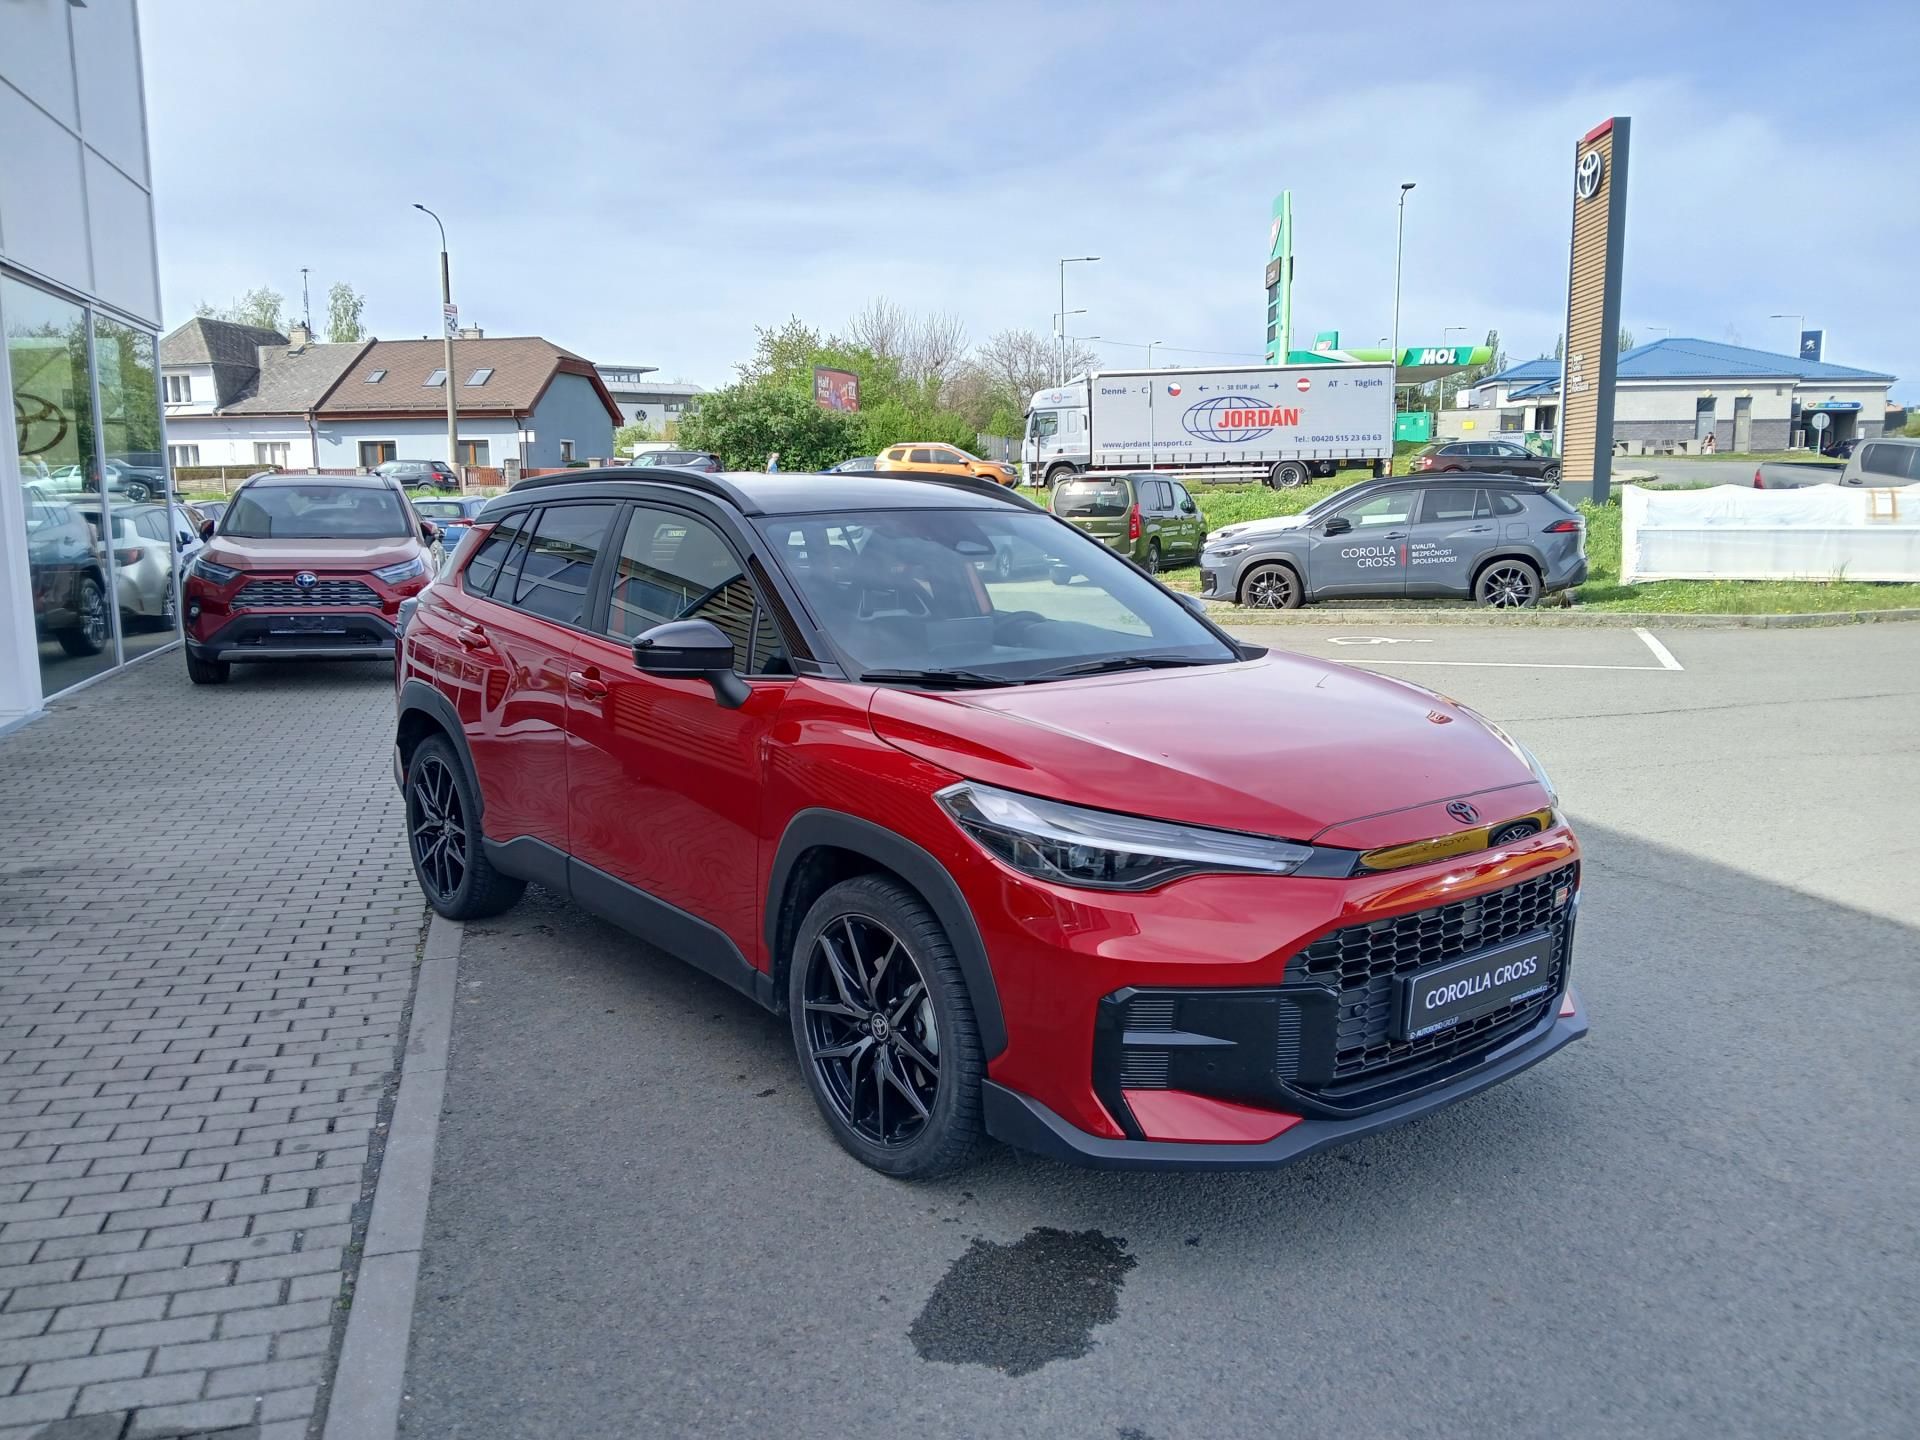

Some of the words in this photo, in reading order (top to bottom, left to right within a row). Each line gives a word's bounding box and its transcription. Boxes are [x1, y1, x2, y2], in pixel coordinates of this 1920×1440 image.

[1419, 348, 1457, 365] MOL
[1328, 380, 1339, 388] AT
[1354, 379, 1383, 388] Täglich
[1101, 387, 1127, 395] Denně
[1218, 405, 1298, 428] JORDÁN
[1102, 439, 1193, 449] www.jordantansport.cz
[1341, 546, 1396, 558] COROLLA
[1411, 548, 1453, 557] BEZPEČNOST
[1357, 556, 1396, 568] CROSS
[1412, 556, 1458, 565] SPOLEHLIVOST
[1425, 972, 1491, 1009] COROLLA
[1494, 956, 1538, 986] CROSS
